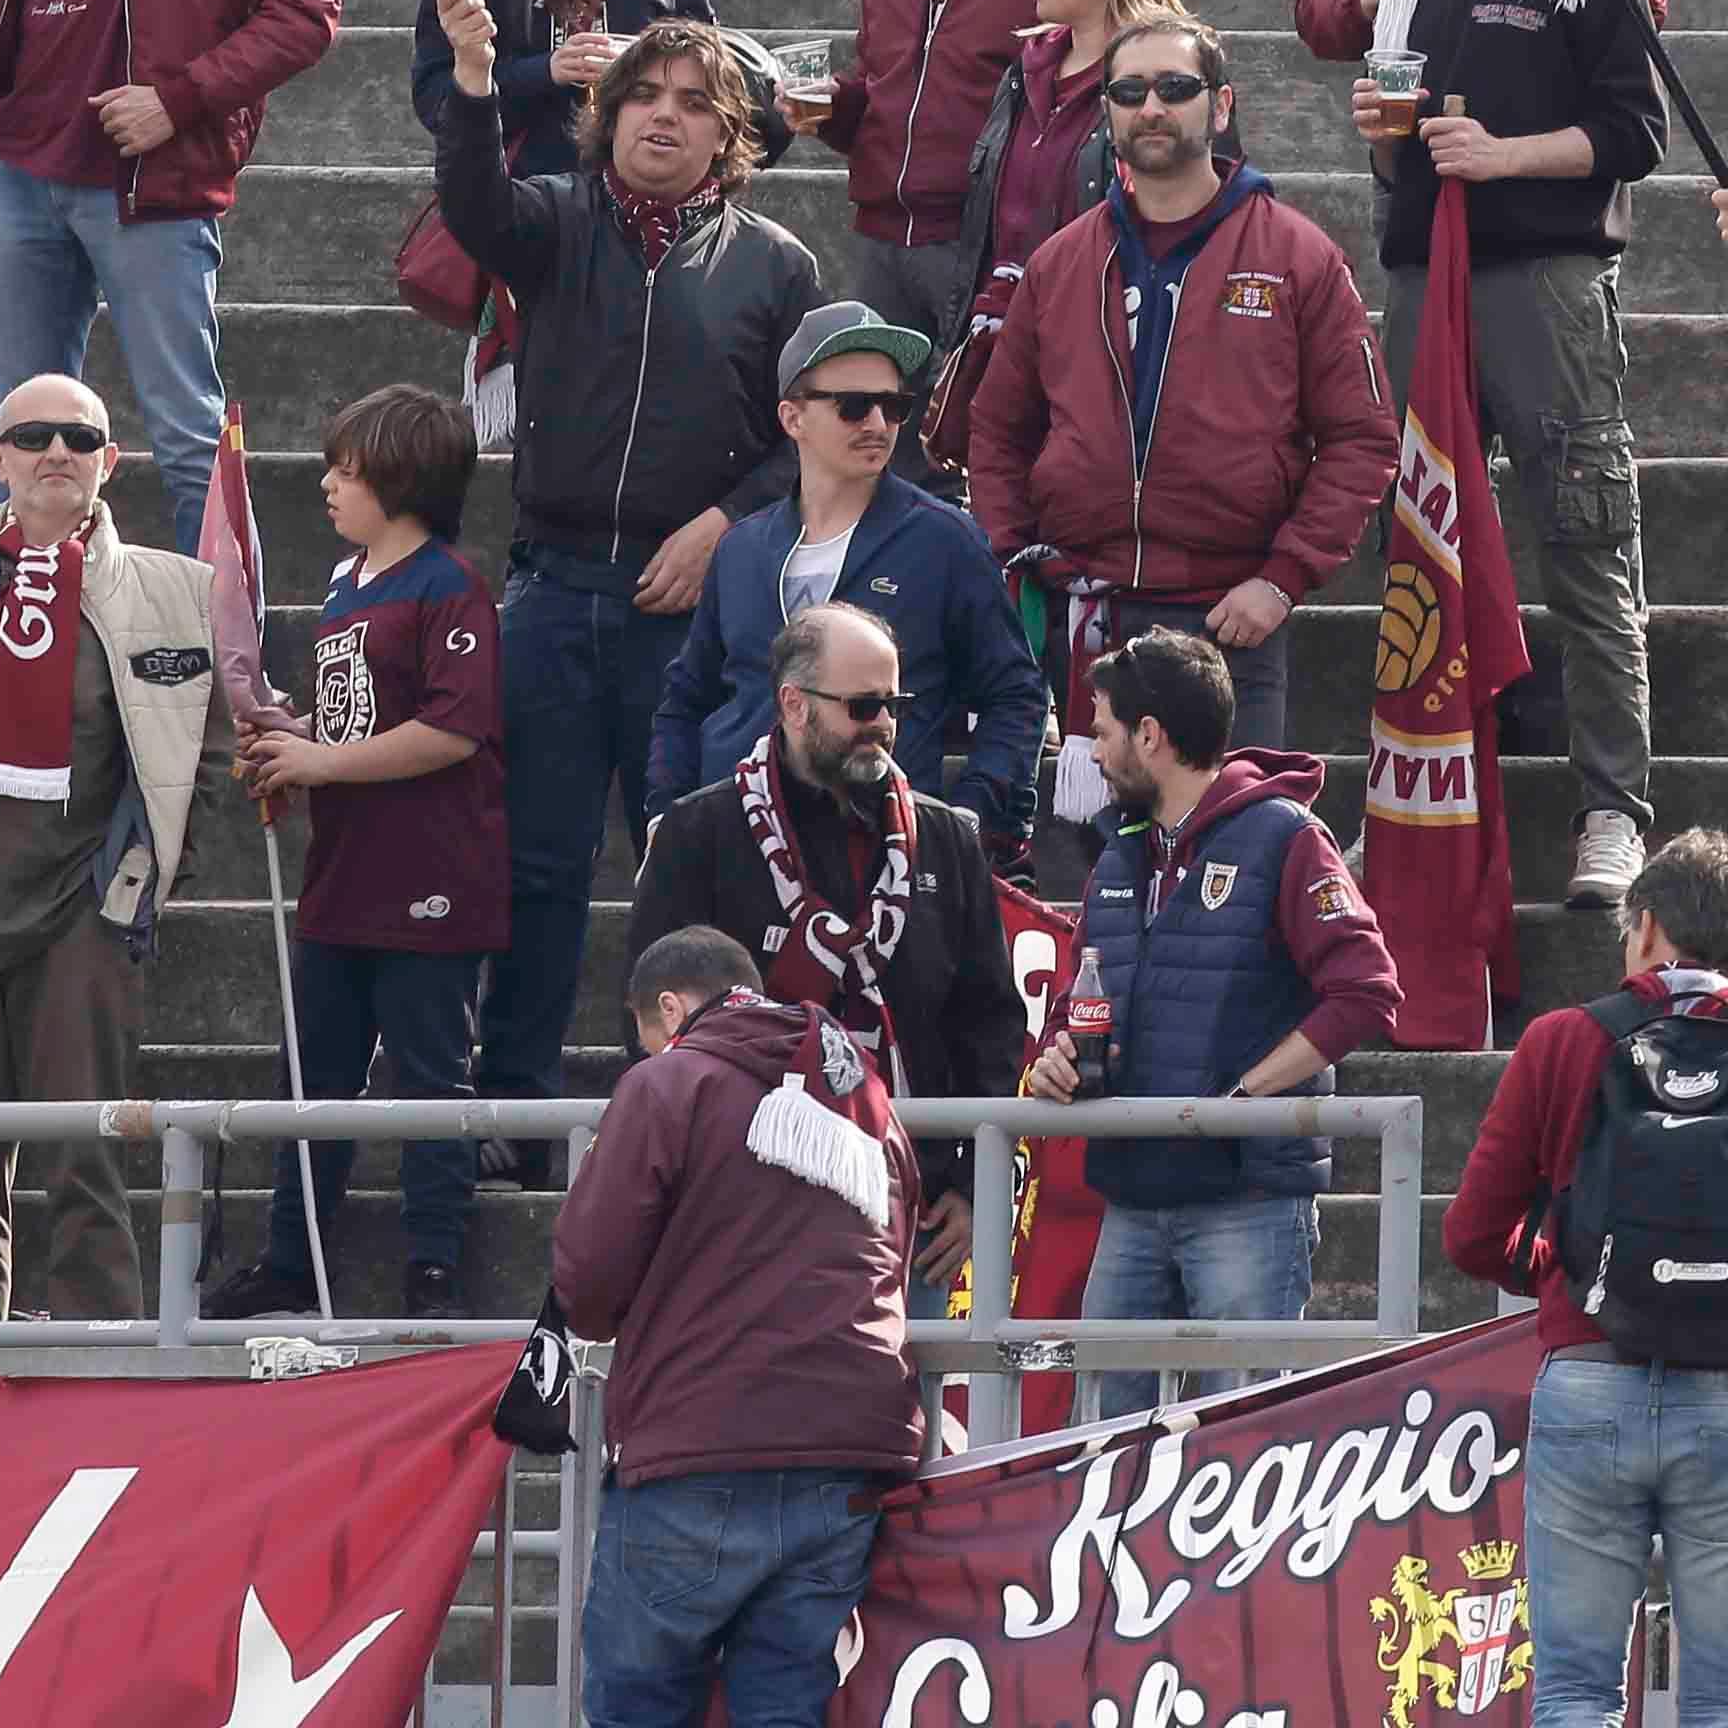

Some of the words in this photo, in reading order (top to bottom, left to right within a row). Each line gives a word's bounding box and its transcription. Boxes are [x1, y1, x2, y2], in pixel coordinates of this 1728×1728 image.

[1003, 1390, 1519, 1639] Reggio
[1468, 1603, 1487, 1639] S
[1494, 1596, 1512, 1633] P
[1463, 1660, 1478, 1699] Q
